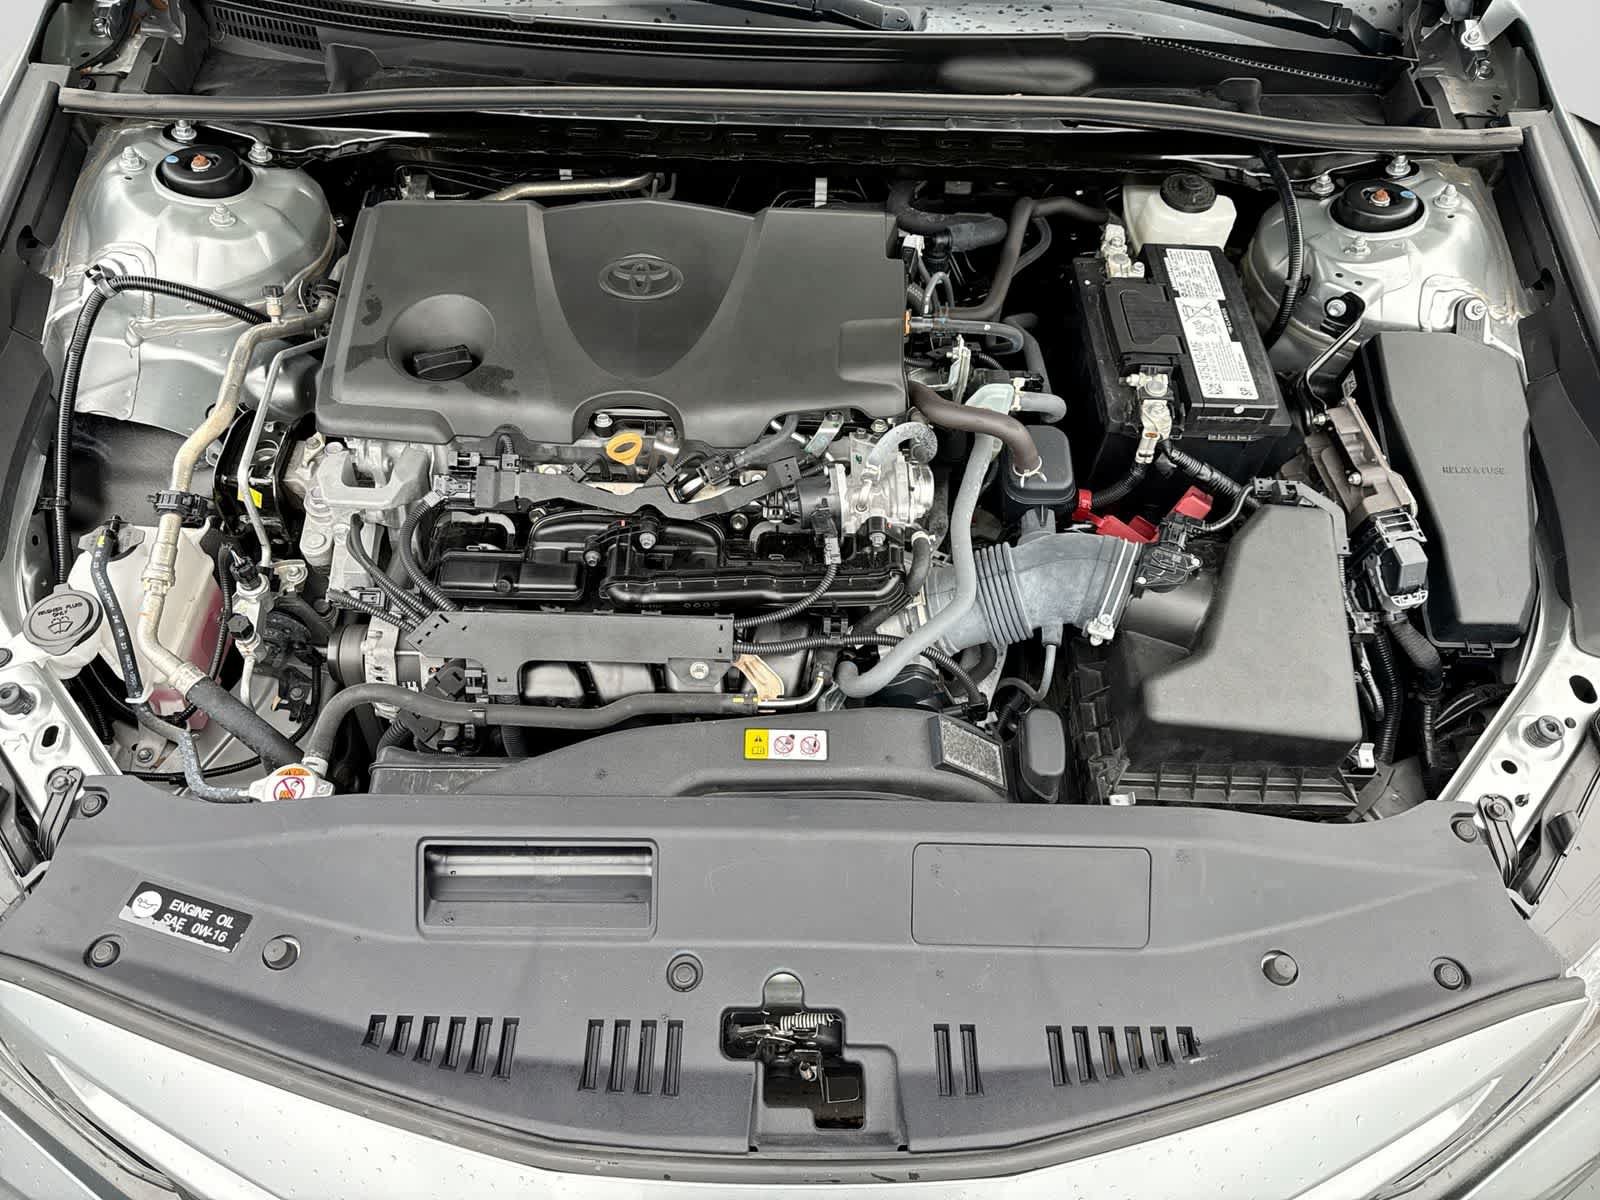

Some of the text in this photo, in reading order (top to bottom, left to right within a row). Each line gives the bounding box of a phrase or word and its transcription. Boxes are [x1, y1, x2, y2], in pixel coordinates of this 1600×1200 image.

[163, 914, 228, 943] SAE 0W-16
[169, 899, 235, 929] ENGINE OIL
